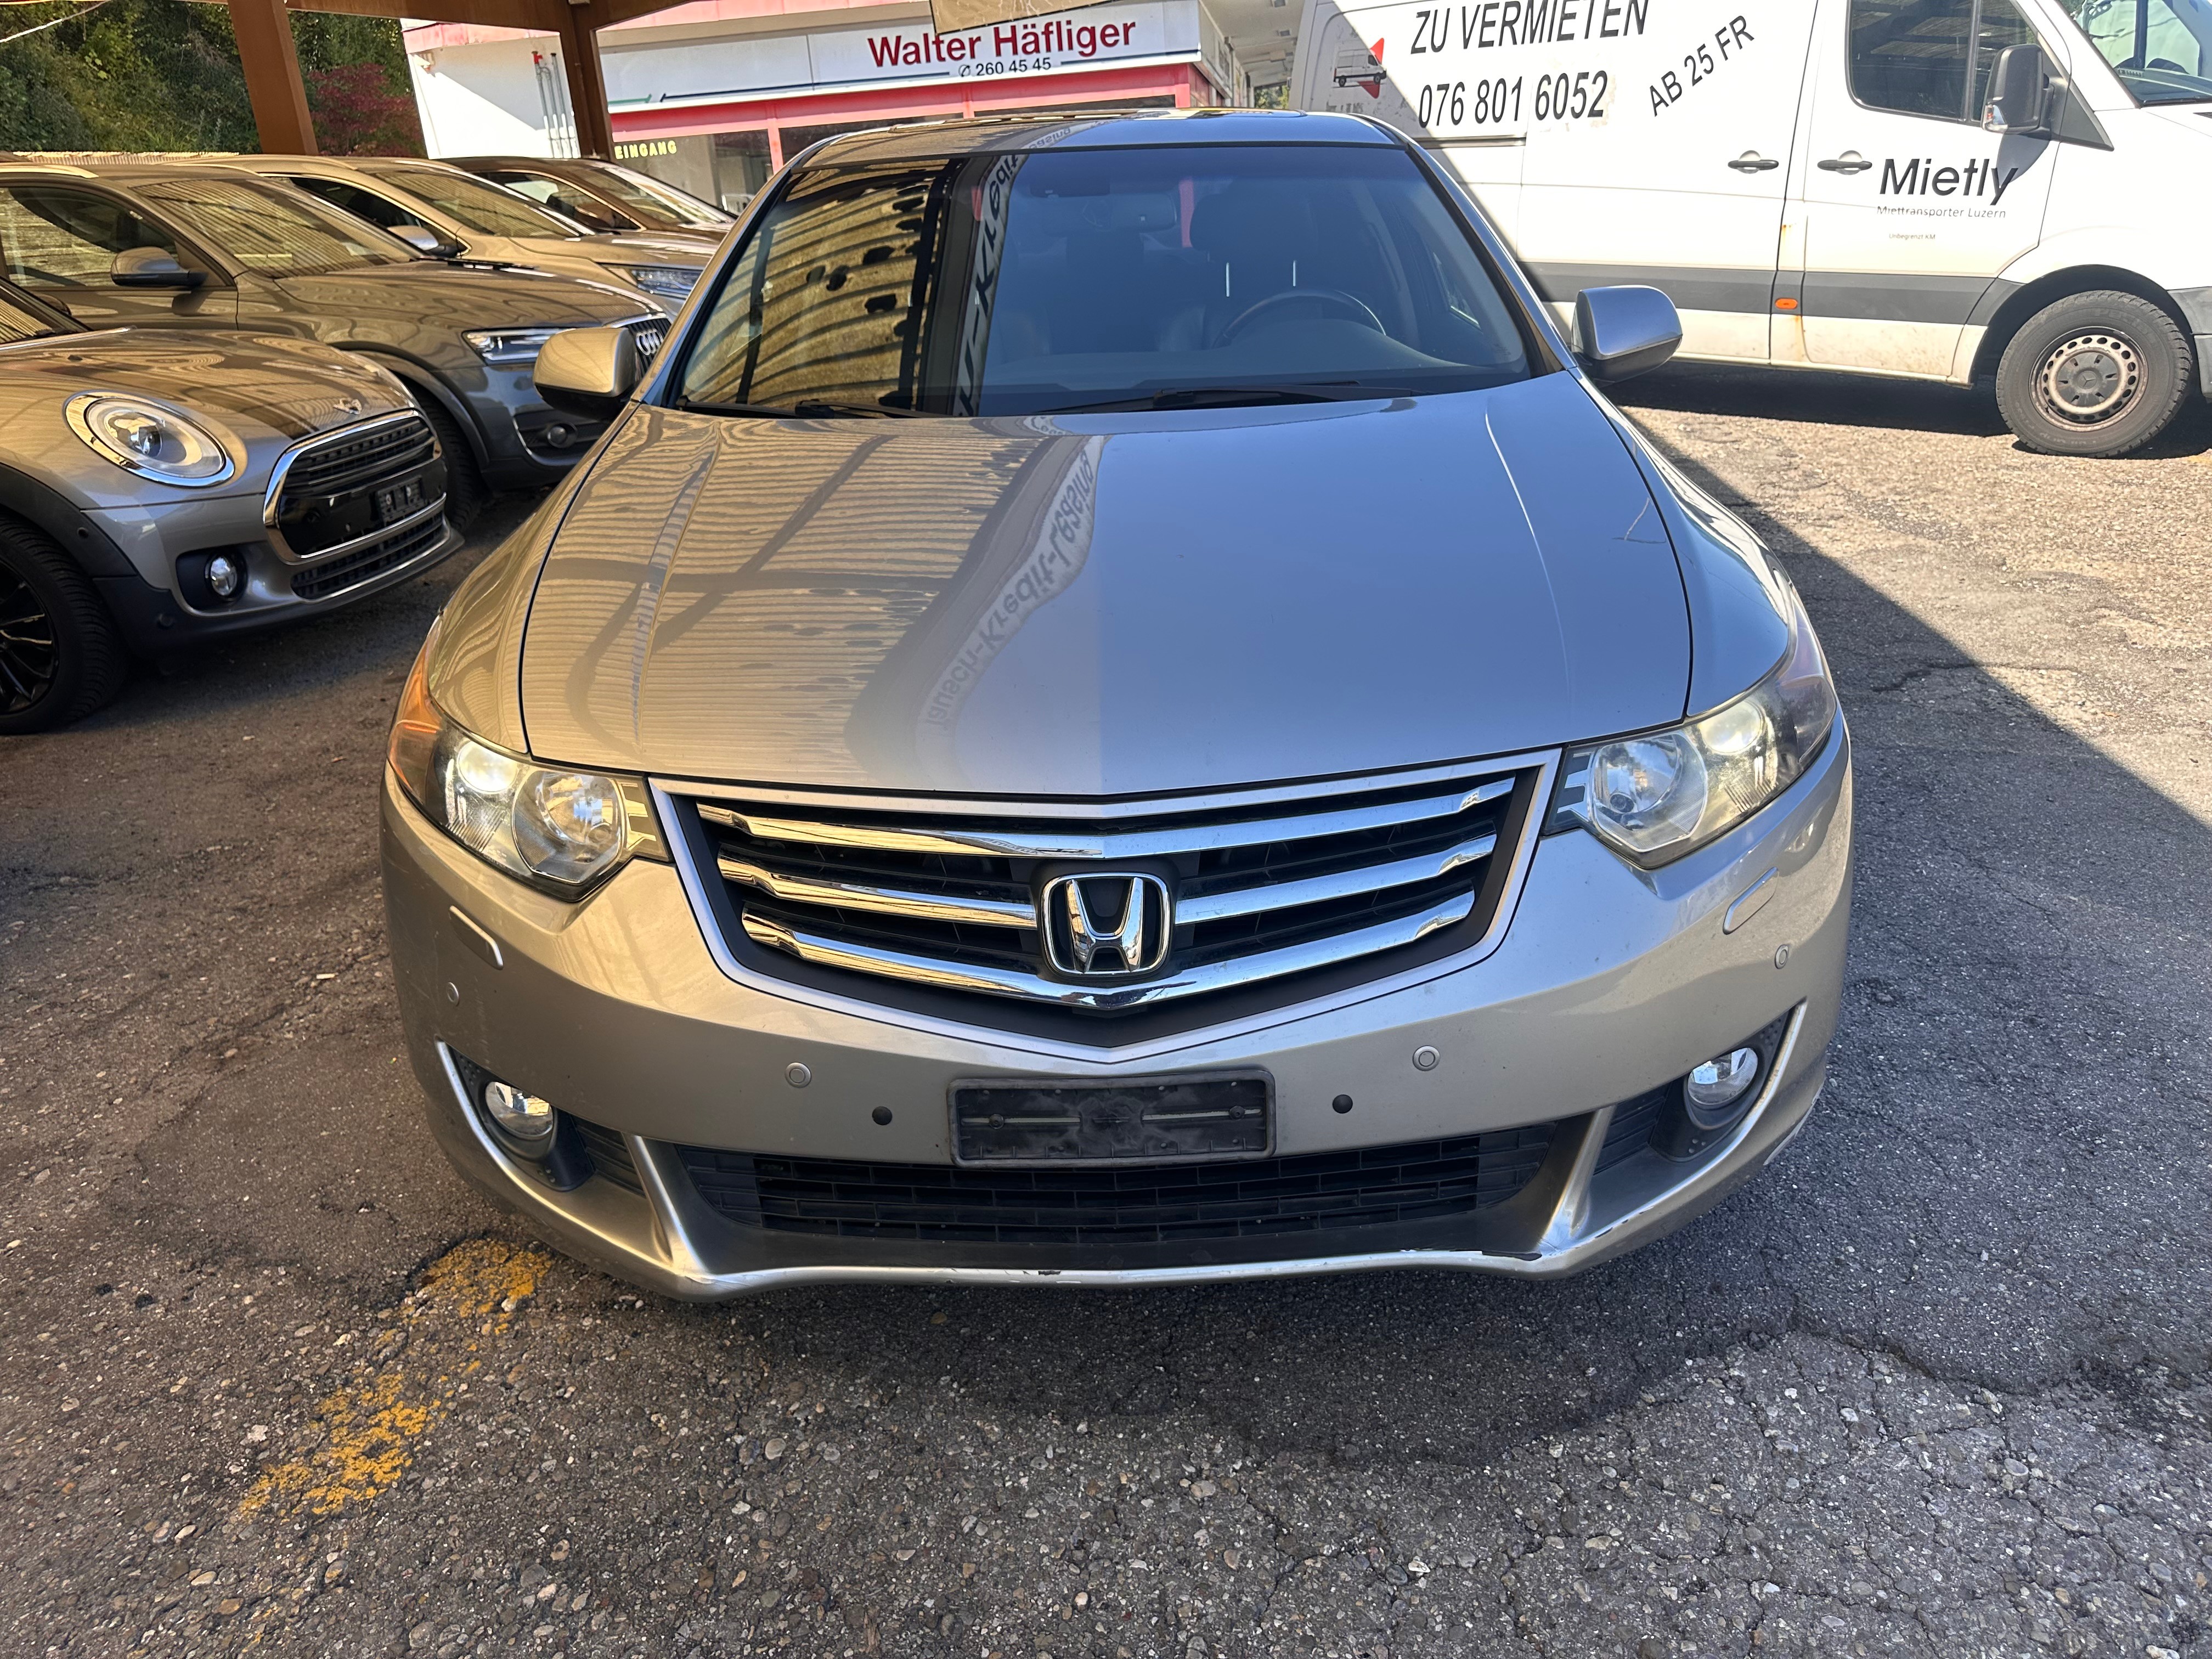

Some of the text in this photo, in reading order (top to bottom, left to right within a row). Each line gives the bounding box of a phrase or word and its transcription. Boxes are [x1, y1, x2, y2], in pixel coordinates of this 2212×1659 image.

[868, 20, 1136, 67] Walter Häfliger
[1410, 0, 1649, 54] ZU VERMIETEN
[975, 57, 1051, 76] 260 45 45
[1650, 15, 1754, 117] AB 25 FR
[1419, 70, 1608, 128] 076 801 6052
[614, 140, 677, 159] EINGANG
[1880, 159, 2019, 206] Mietly
[1876, 206, 2006, 218] Miettransporter Luzern
